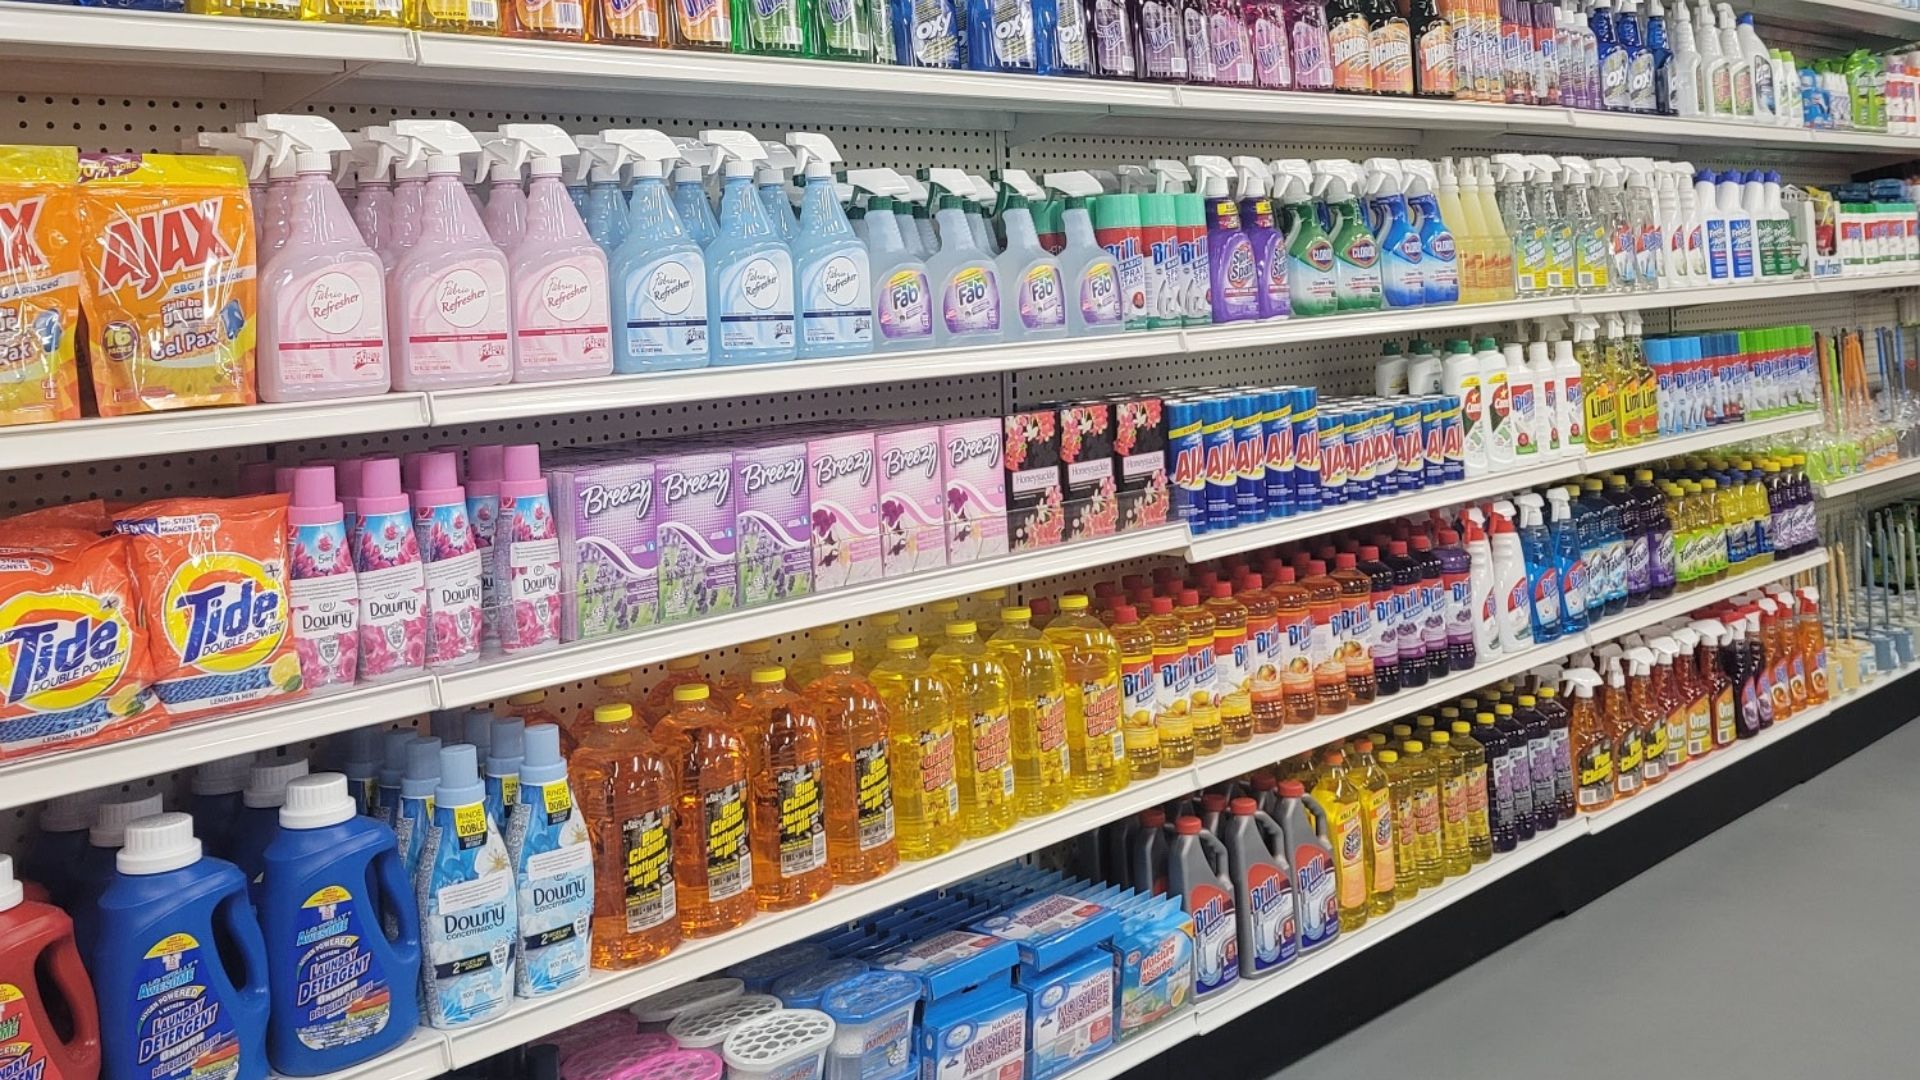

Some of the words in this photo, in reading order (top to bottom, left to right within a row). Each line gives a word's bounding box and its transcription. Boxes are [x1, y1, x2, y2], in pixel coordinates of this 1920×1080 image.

[100, 197, 231, 298] AJAX
[173, 281, 195, 294] SBG
[653, 279, 691, 302] Refresher
[746, 276, 778, 297] Refresher
[826, 273, 857, 294] Refresher
[958, 281, 985, 306] Fab
[1031, 277, 1053, 302] Fab
[1091, 277, 1112, 298] Fab
[313, 293, 359, 319] Refresher
[442, 289, 486, 313] Refresher
[547, 285, 588, 308] Refresher
[892, 283, 919, 310] Fab
[163, 308, 204, 327] gone
[104, 328, 132, 346] 16
[150, 335, 182, 361] Gel
[185, 329, 218, 352] Pax
[947, 433, 1000, 468] Breezy
[1236, 432, 1265, 475] AJA
[1265, 425, 1294, 466] AJA
[813, 448, 873, 487] Breezy
[883, 442, 937, 479] Breezy
[1206, 437, 1236, 480] AJA
[661, 467, 731, 507] Breezy
[741, 458, 804, 495] Breezy
[579, 478, 653, 520] Breezy
[160, 525, 198, 533] MAGNETS
[173, 517, 196, 525] STAIN
[442, 585, 480, 603] Downy
[522, 575, 557, 592] Downy
[302, 611, 352, 630] Downy
[369, 598, 418, 618] Downy
[177, 580, 279, 665] Tide
[202, 633, 245, 656] DOUBLE
[245, 622, 284, 642] POWER
[2, 617, 119, 705] Tide
[31, 668, 84, 693] DOUBLE
[210, 694, 234, 705] LEMON
[235, 694, 242, 702] &
[243, 691, 258, 701] MINT
[42, 732, 71, 743] LEMON
[80, 725, 100, 736] MINT
[504, 782, 518, 793] RIN
[546, 786, 567, 797] RINDE
[457, 809, 482, 819] RINDE
[547, 798, 570, 811] DOBLE
[460, 820, 485, 834] DOBLE
[1298, 854, 1323, 893] Brillo
[533, 878, 587, 907] Downy
[535, 896, 577, 914] CONCENTRADO
[1252, 873, 1281, 913] Brillo
[444, 905, 507, 935] Downy
[1193, 894, 1223, 933] Brillo
[296, 918, 349, 946] AWESOME
[315, 936, 352, 951] POWERED
[446, 923, 495, 941] CONCENTRADO
[541, 933, 549, 946] 2
[309, 946, 359, 983] LAUNDRY
[453, 962, 460, 975] 2
[1141, 944, 1176, 973] Moisture
[137, 967, 196, 1000] AWESOME
[297, 952, 371, 1007] DETERGENT
[1082, 971, 1111, 990] HANGING
[158, 987, 199, 1005] POWERED
[1058, 980, 1110, 1019] MOISTURE
[152, 996, 207, 1035] LAUNDRY
[991, 1011, 1024, 1031] HANGING
[1056, 993, 1110, 1035] ABSORBER
[138, 1002, 219, 1064] DETERGENT
[965, 1020, 1022, 1060] MOISTURE
[963, 1036, 1022, 1078] ABSORBER
